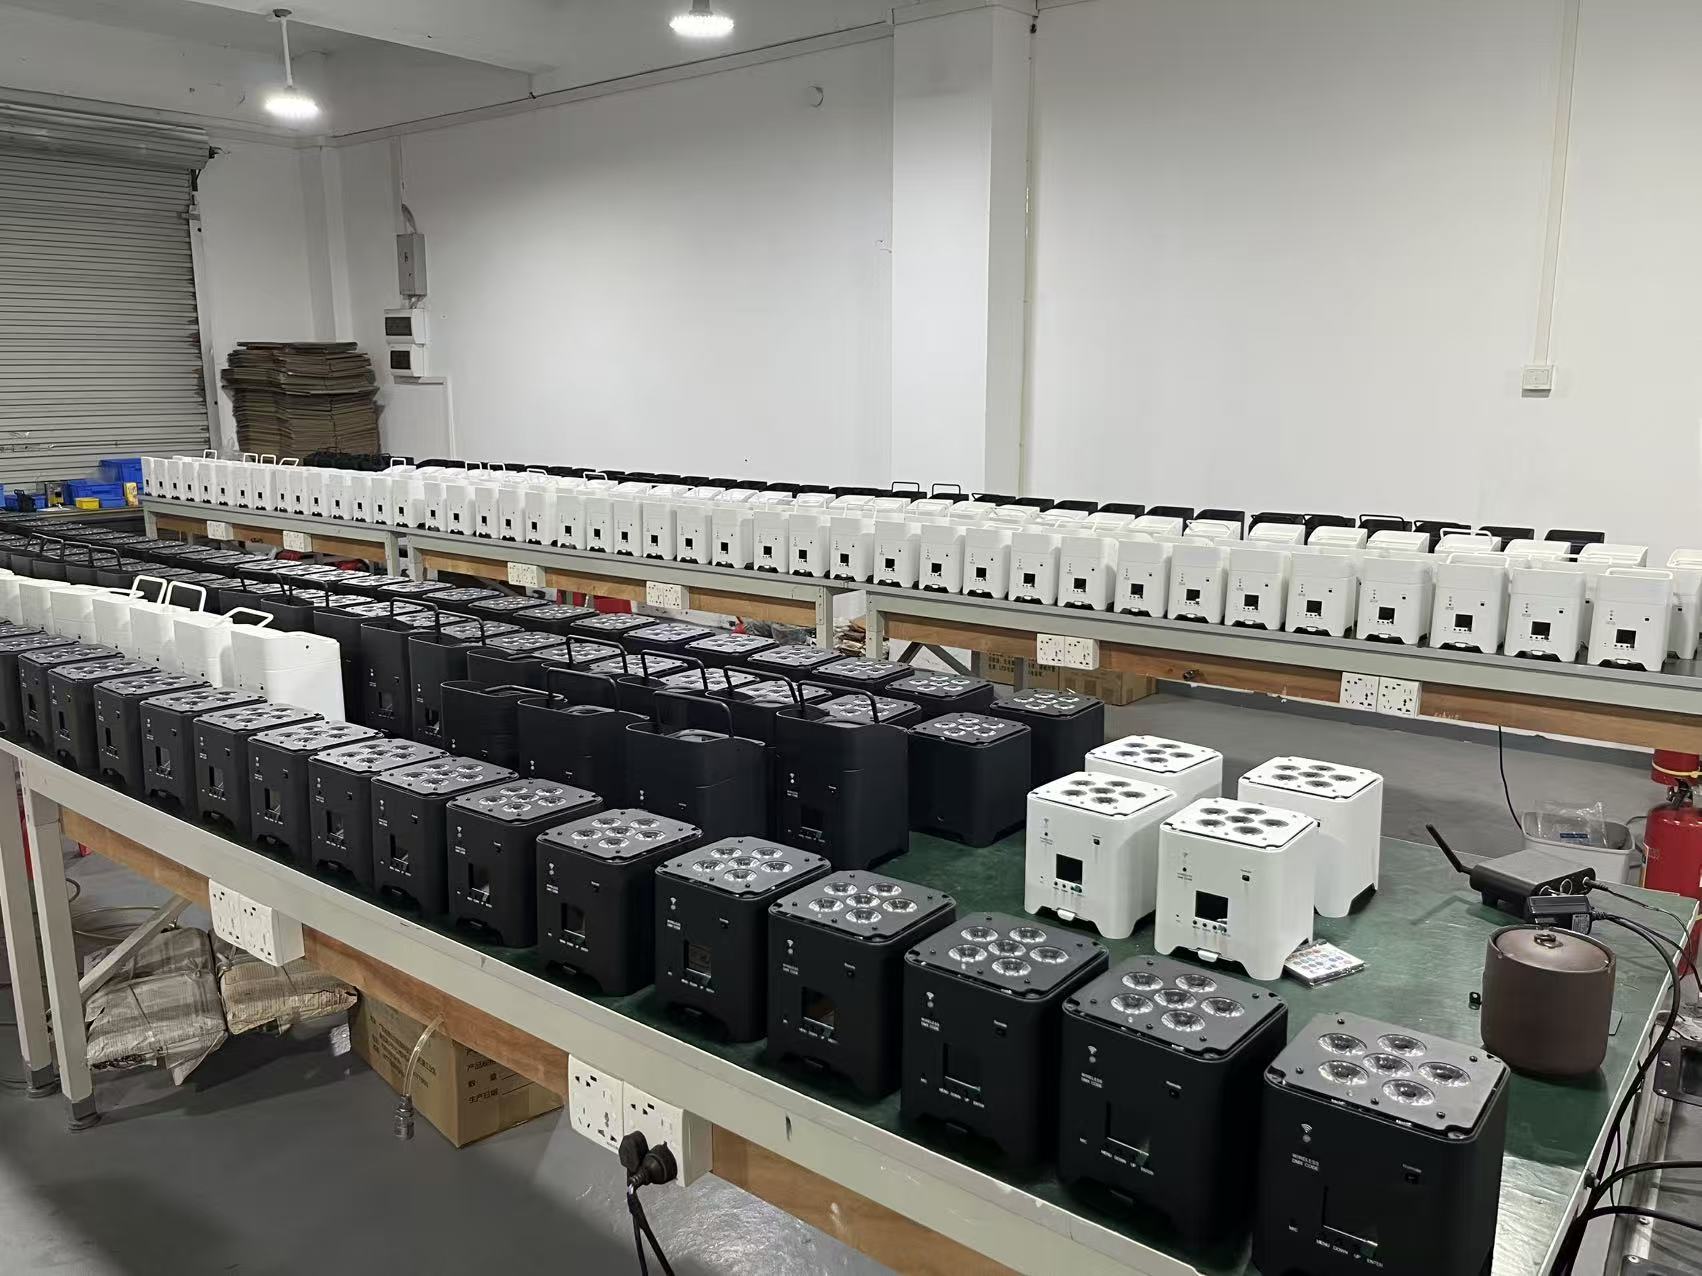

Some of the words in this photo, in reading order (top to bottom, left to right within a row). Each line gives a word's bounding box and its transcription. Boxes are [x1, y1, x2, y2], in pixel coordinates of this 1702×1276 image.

[1291, 1153, 1320, 1166] WIRELESS
[1304, 1163, 1319, 1171] CODE
[1316, 1239, 1330, 1248] MENU
[1332, 1245, 1349, 1255] DOWN
